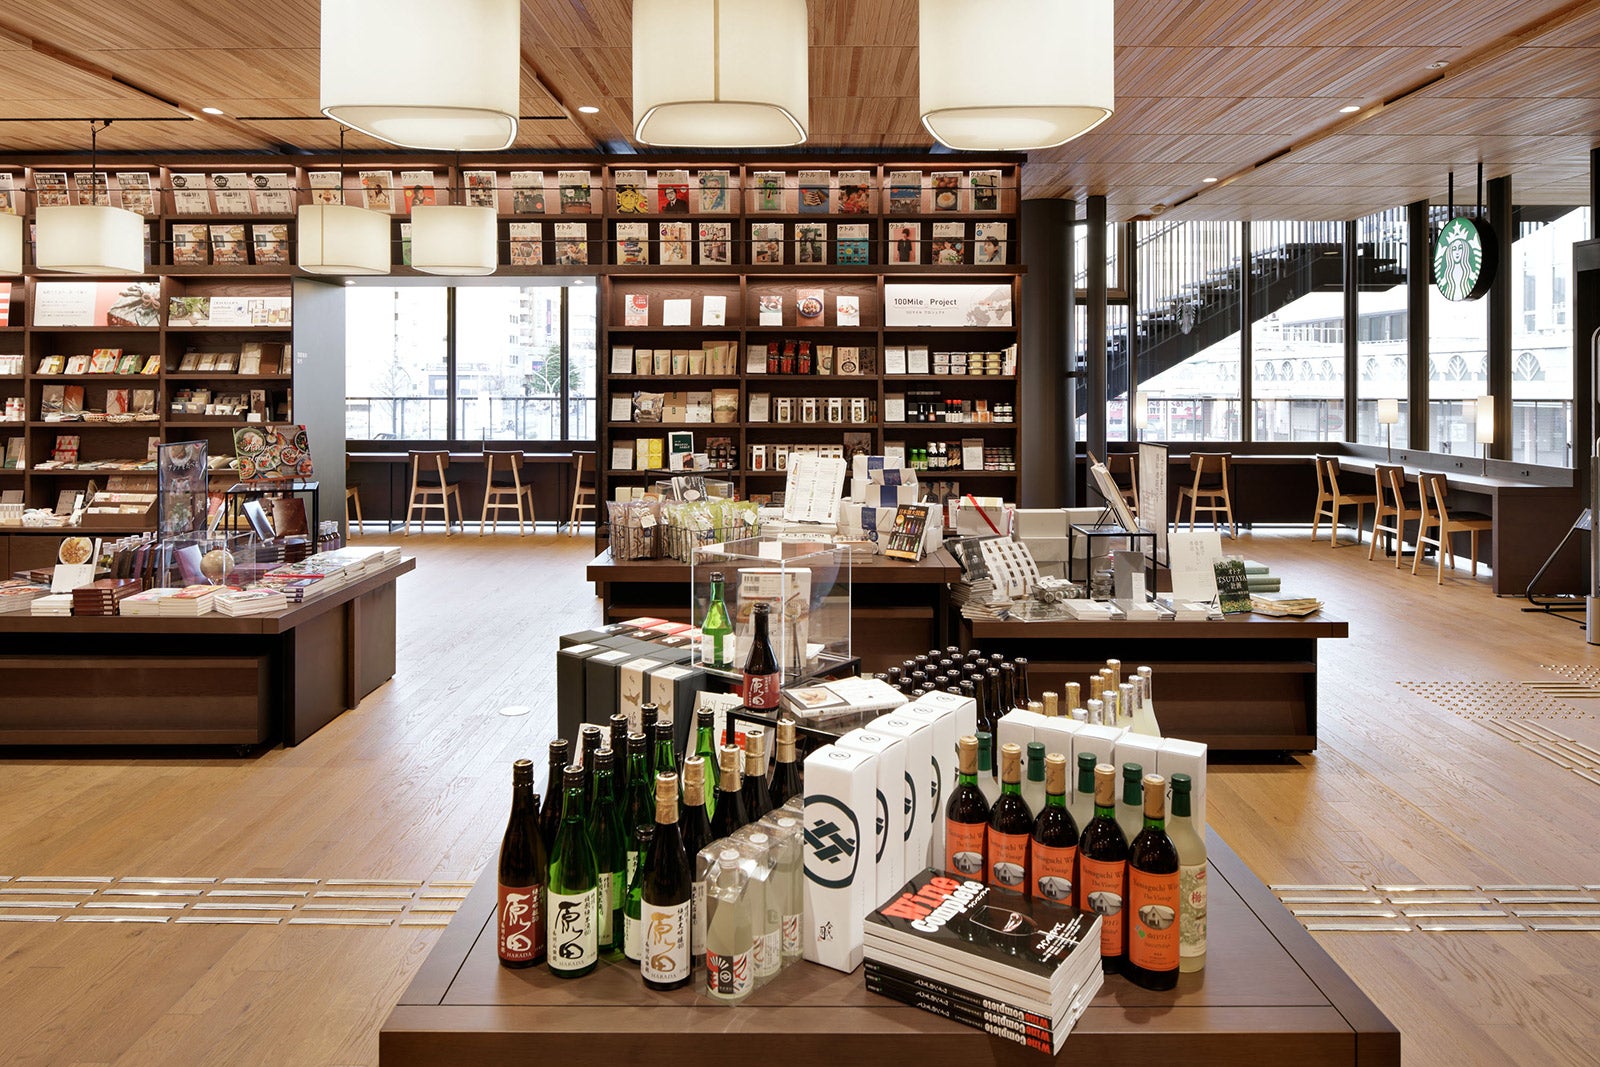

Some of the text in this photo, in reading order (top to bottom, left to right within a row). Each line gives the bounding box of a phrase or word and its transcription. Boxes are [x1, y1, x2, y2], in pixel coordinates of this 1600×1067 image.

[894, 297, 957, 307] 100Mile Project
[880, 876, 960, 921] Wine
[910, 880, 984, 932] Complete
[982, 999, 1049, 1029] Wine Complete
[983, 1012, 1050, 1043] Wine Complete
[984, 1023, 1051, 1055] Wine Complete
